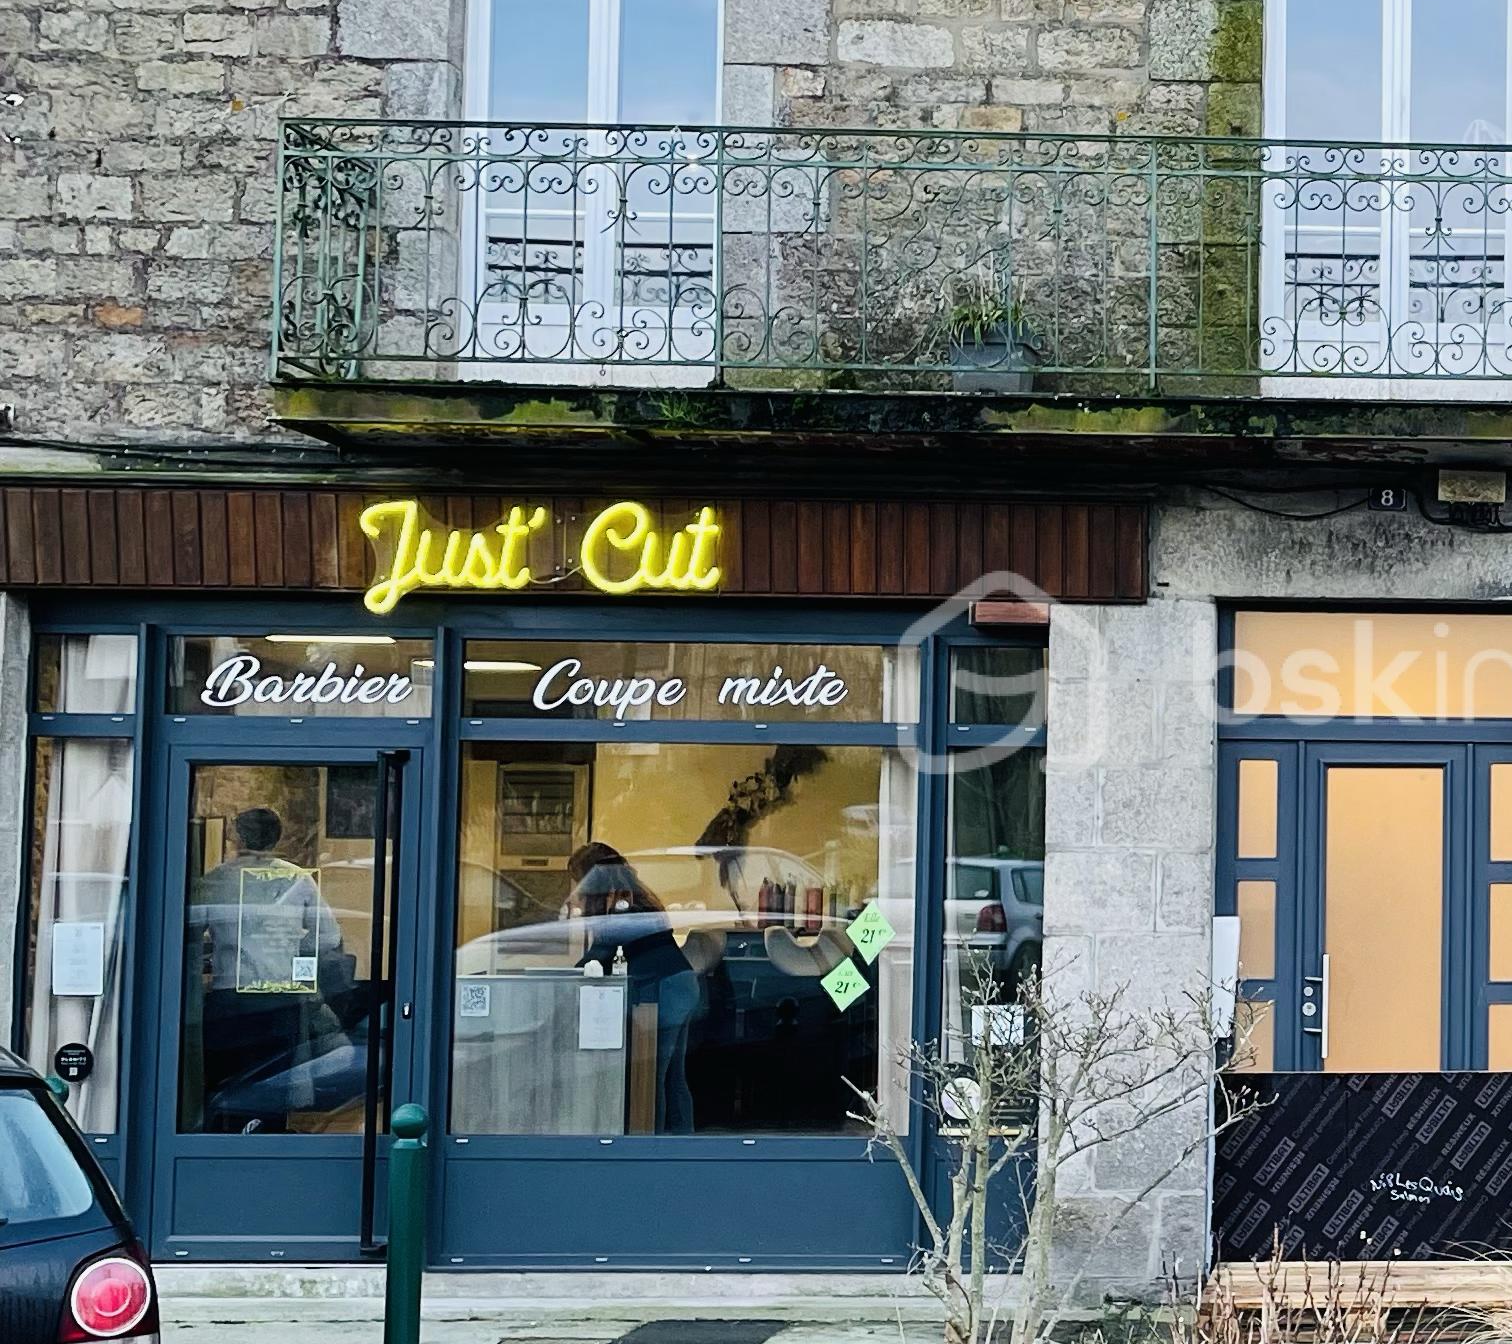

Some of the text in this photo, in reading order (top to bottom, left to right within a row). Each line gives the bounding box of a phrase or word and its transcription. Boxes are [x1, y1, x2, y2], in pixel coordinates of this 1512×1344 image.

[1380, 489, 1394, 506] 8
[580, 501, 722, 595] Cut
[200, 654, 413, 708] Barbier
[532, 658, 849, 720] Coupe mixte
[1415, 1094, 1458, 1145] ULTIBAT
[1252, 1136, 1296, 1186] ULTIBAT
[1450, 1120, 1493, 1171] ULTIBAT
[1287, 1163, 1330, 1213] ULTIBAT
[1419, 1176, 1464, 1201] Quais
[1229, 1198, 1271, 1248] ULTIBAT
[1321, 1189, 1365, 1240] ULTIBAT
